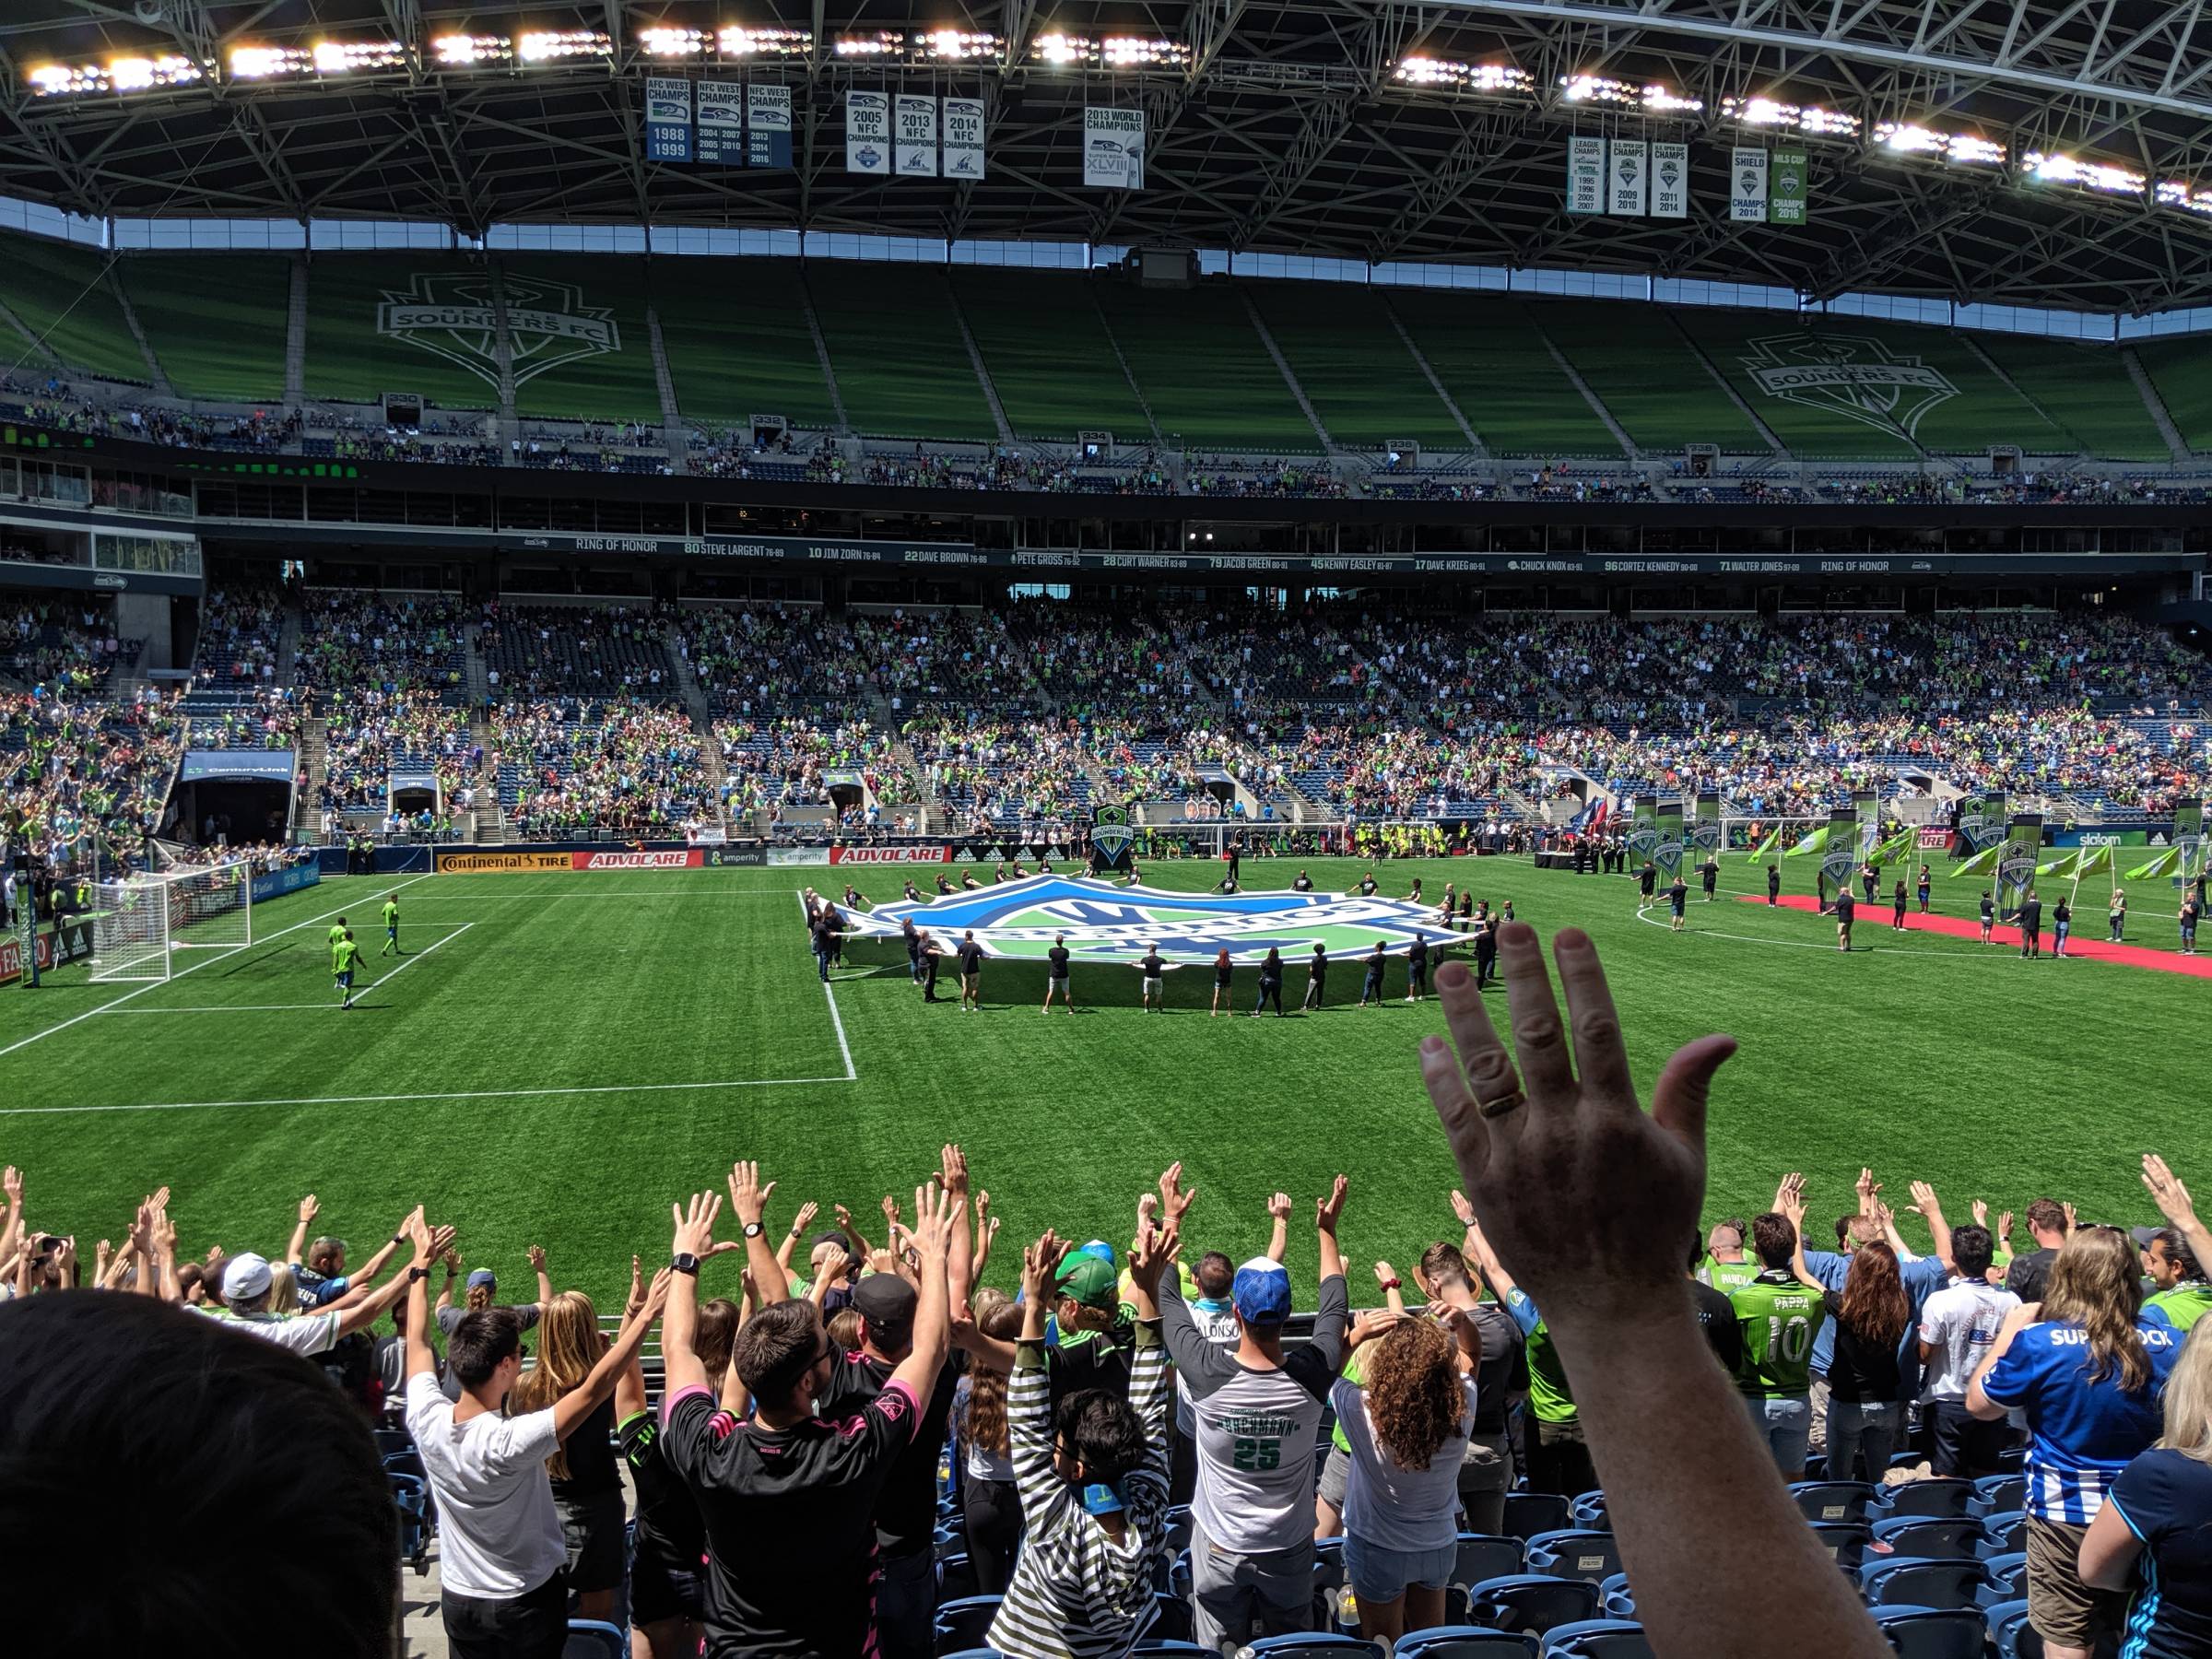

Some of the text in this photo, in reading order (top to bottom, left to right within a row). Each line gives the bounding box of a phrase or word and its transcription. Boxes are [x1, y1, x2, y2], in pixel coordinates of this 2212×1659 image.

[649, 80, 688, 89] AFC WEST
[717, 84, 740, 93] WEST
[649, 89, 688, 101] CHAMPS
[749, 87, 789, 97] NFC WEST
[700, 92, 741, 104] CHAMPS
[749, 96, 790, 108] CHAMPS
[853, 111, 881, 124] 2005
[902, 114, 930, 127] 2013
[1088, 110, 1141, 122] 2013 WORLD
[857, 124, 878, 134] NFC
[950, 118, 977, 130] 2014
[1088, 120, 1141, 132] CHAMPIONS
[654, 128, 685, 141] 1988
[699, 129, 718, 137] 2004
[723, 130, 740, 138] 2007
[751, 133, 768, 141] 2013
[906, 128, 925, 138] NFC
[954, 131, 974, 141] NFC
[700, 140, 718, 148] 2005
[848, 134, 888, 144] CHAMPIONS
[897, 138, 935, 147] CHAMPIONS
[1575, 140, 1599, 148] LEAGUE
[654, 143, 685, 156] 1999
[751, 144, 768, 152] 2014
[945, 141, 983, 150] CHAMPIONS
[1614, 148, 1644, 157] CHAMPS
[1655, 151, 1685, 160] CHAMPS
[751, 155, 769, 163] 2016
[1735, 158, 1764, 167] SHIELD
[1774, 155, 1806, 164] MLS CUP
[1087, 159, 1127, 171] XLVIII
[1618, 190, 1637, 199] 2009
[1660, 193, 1677, 202] 2011
[1618, 200, 1637, 209] 2010
[1660, 203, 1677, 211] 2014
[1733, 199, 1765, 208] CHAMPS
[1773, 198, 1805, 209] CHAMPS
[1739, 208, 1758, 217] 2014
[1778, 208, 1799, 218] 2016
[570, 324, 603, 339] FC
[1901, 374, 1936, 384] FC
[389, 394, 418, 403] 330
[755, 416, 781, 425] 332
[1083, 432, 1106, 441] 334
[576, 538, 657, 553] RING OF HONOR
[685, 543, 700, 553] 80
[701, 544, 726, 556] STEVE
[727, 545, 765, 557] LARGENT
[808, 547, 822, 559] 10
[822, 548, 839, 559] JIM
[841, 549, 862, 560] ZORN
[905, 551, 918, 561] 22
[918, 551, 938, 562] DAVE
[940, 552, 969, 563] BROWN
[1018, 553, 1036, 565] PETE
[1038, 554, 1063, 566] GROSS
[1103, 557, 1116, 566] 28
[1116, 558, 1136, 567] CURT
[1137, 558, 1170, 568] WARNER
[1210, 559, 1222, 568] 79
[1223, 559, 1245, 569] JACOB
[1247, 559, 1271, 569] GREEN
[1311, 559, 1324, 570] 45
[1324, 559, 1348, 571] KENNY
[1350, 560, 1376, 571] EASLEY
[1415, 559, 1426, 571] 17
[1427, 560, 1444, 571] DAVE
[1446, 560, 1468, 571] KRIEG
[1521, 560, 1546, 571] CHUCK
[1547, 561, 1567, 571] KNOX
[1605, 561, 1618, 571] 96
[1618, 561, 1644, 571] CORTEZ
[1647, 561, 1679, 571] KENNEDY
[1720, 561, 1731, 571] 71
[1732, 561, 1759, 571] WALTER
[1760, 561, 1783, 571] JONES
[1821, 560, 1888, 571] RING OF HONOR
[1092, 830, 1124, 838] SOUNDERS
[2079, 832, 2122, 846] slalom
[588, 851, 688, 869] ADVOCARE
[723, 854, 759, 863] amperity
[787, 853, 823, 861] amperity
[839, 846, 944, 864] ADVOCARE
[441, 855, 569, 873] Continental TIRE
[1774, 1297, 1809, 1310] PAPPA
[1769, 1315, 1810, 1362] 10
[1233, 1438, 1280, 1470] 25
